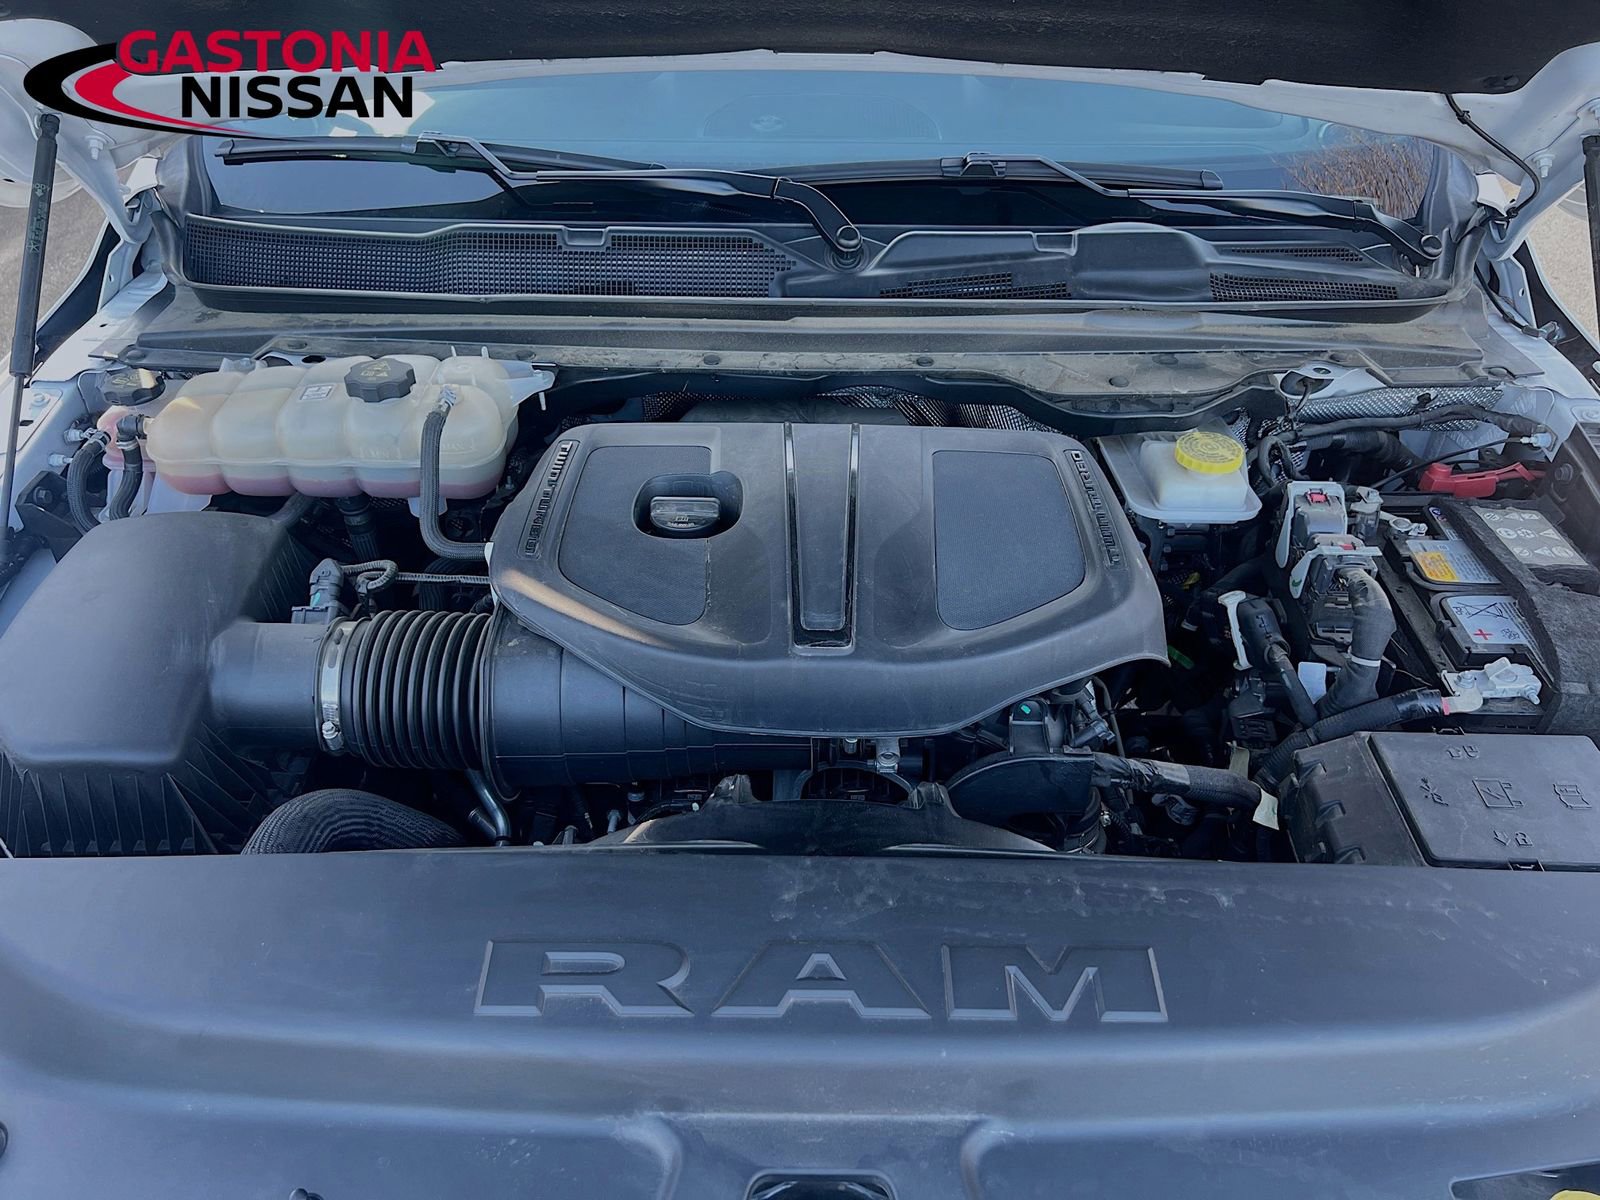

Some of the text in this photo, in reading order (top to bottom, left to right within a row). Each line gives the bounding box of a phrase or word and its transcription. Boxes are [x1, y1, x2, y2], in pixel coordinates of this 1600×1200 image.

[524, 441, 573, 556] TWIN TURBO
[1070, 450, 1102, 511] TURBO
[473, 940, 1168, 1022] RAM
